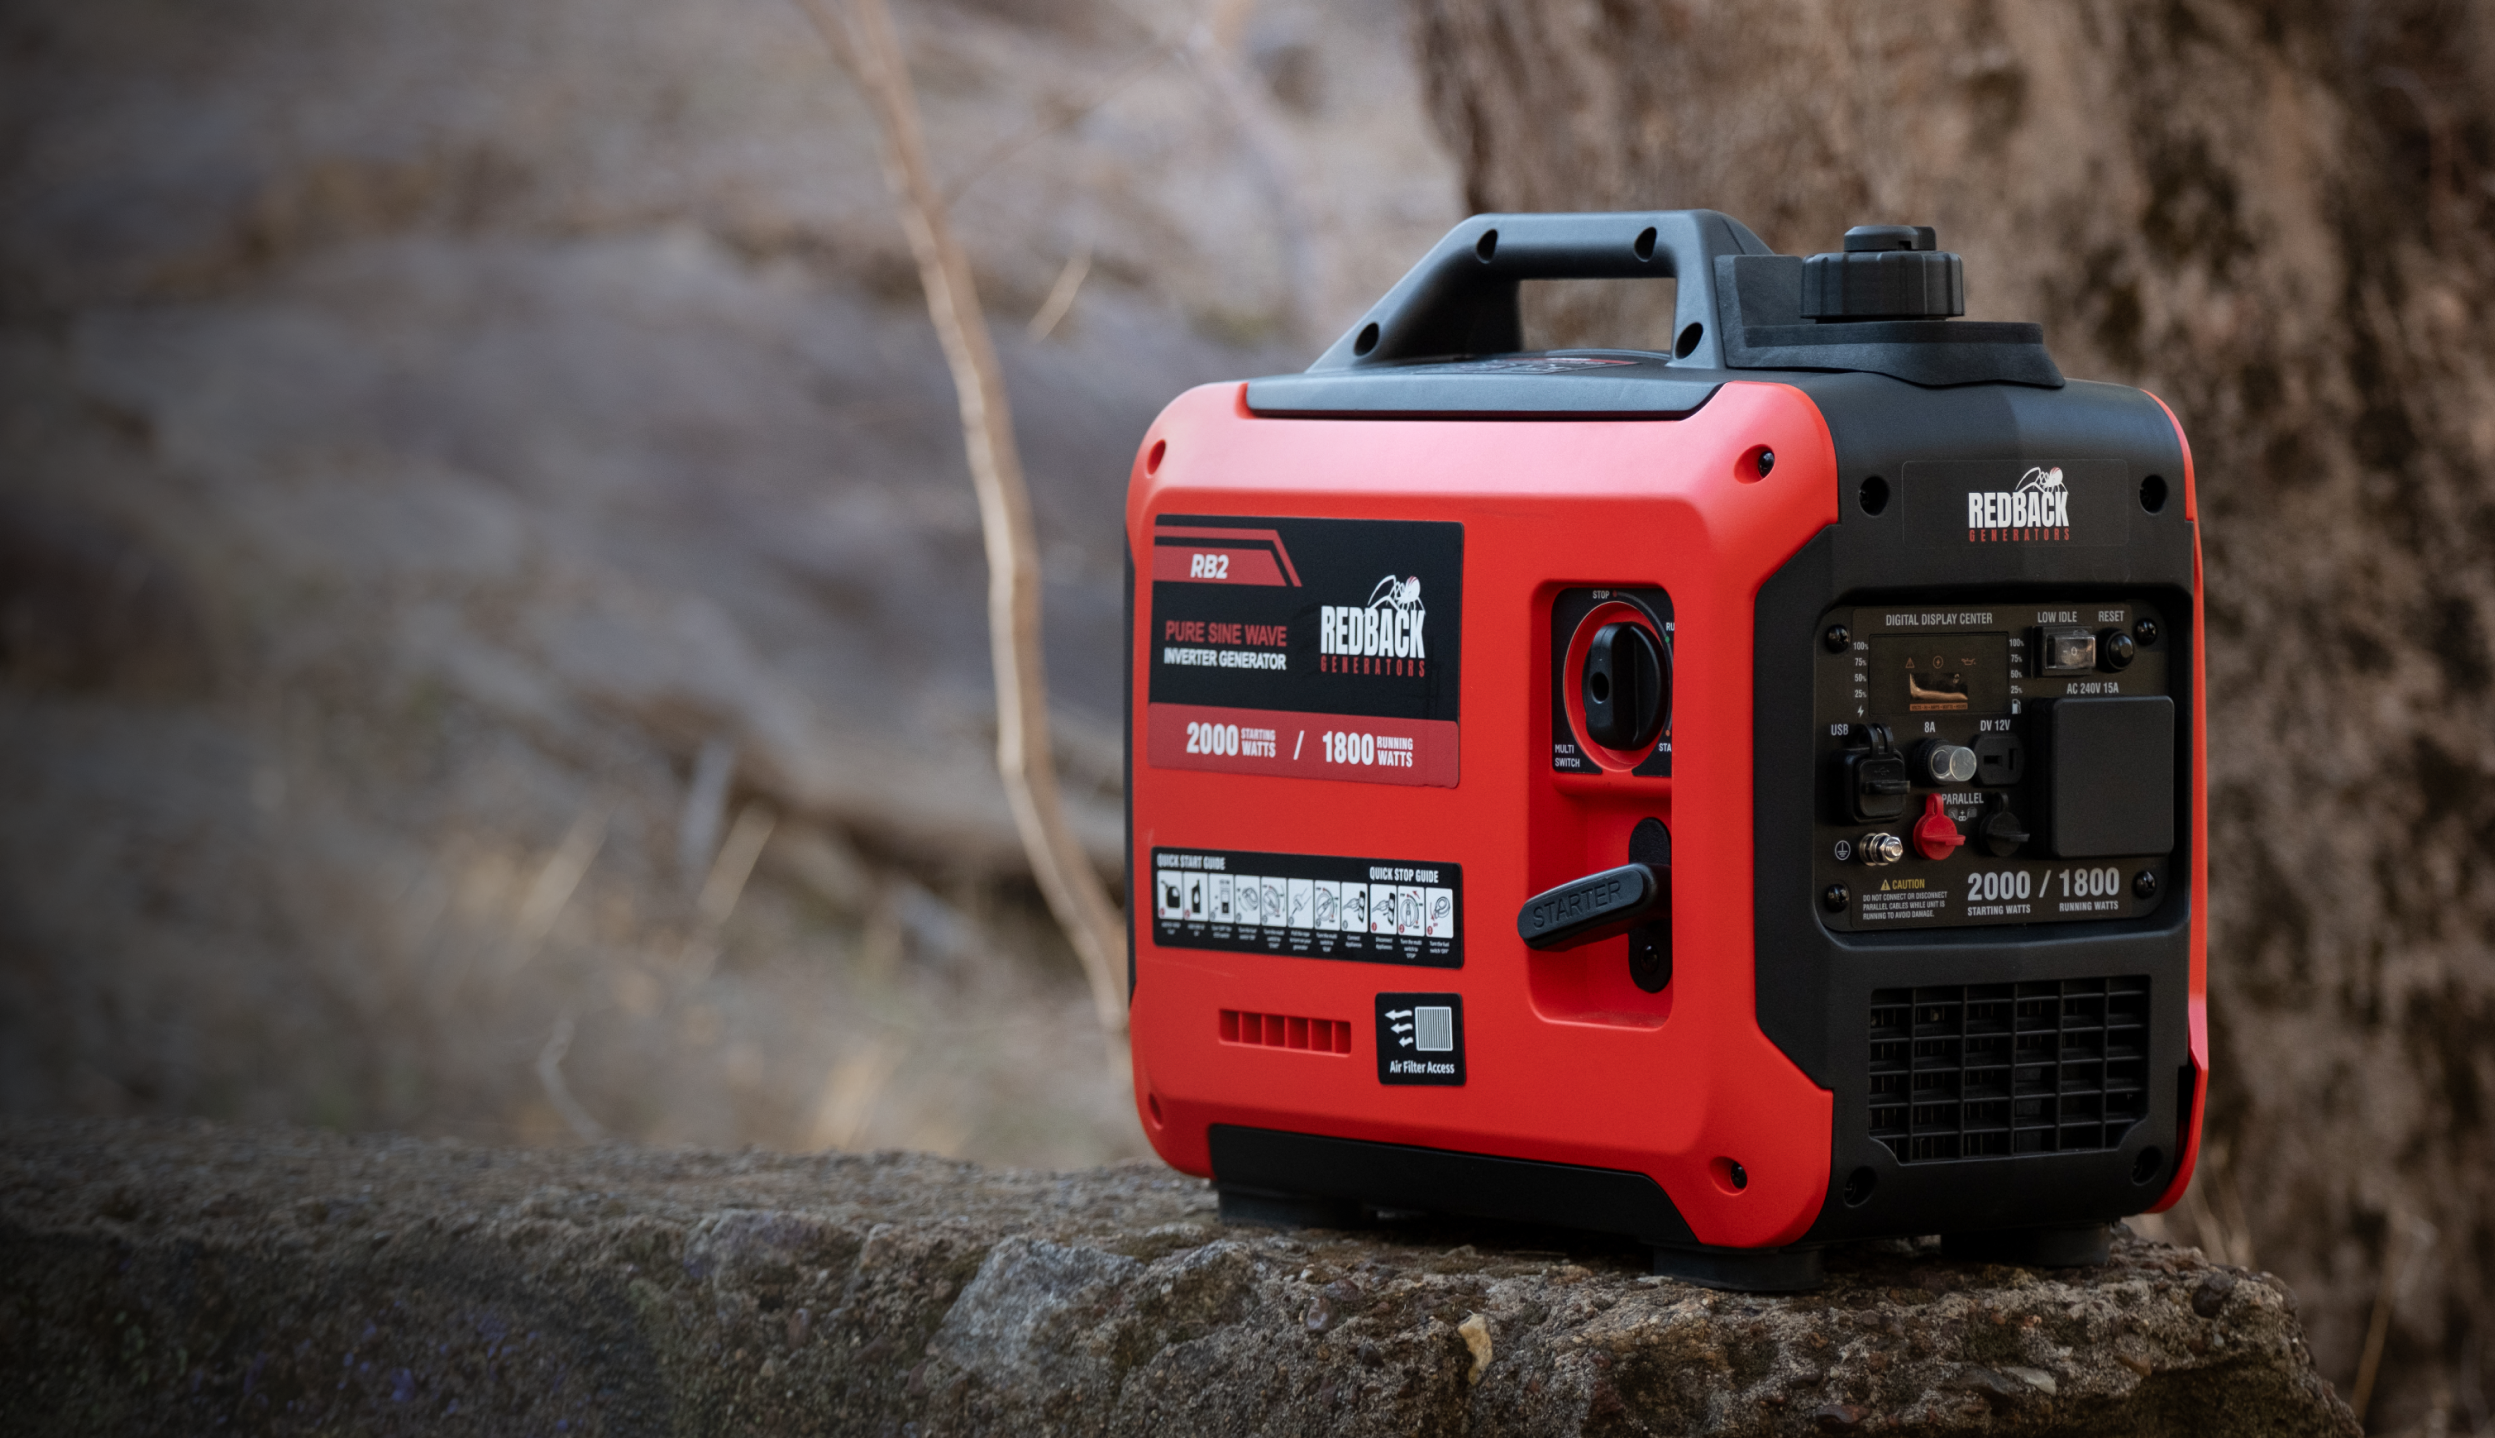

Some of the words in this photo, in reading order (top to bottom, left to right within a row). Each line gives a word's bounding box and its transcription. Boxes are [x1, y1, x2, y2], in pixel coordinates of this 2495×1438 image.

[1968, 491, 2069, 528] REDBACK
[1969, 528, 2069, 542] GENERATORS
[1190, 554, 1229, 579] RB2
[1592, 590, 1610, 599] STOP
[1886, 614, 1919, 626] DIGITAL
[1922, 614, 1957, 626] DISPLAY
[1959, 612, 1992, 625] CENTER
[2038, 612, 2056, 623] LOW
[2058, 611, 2078, 622] IDLE
[2098, 610, 2124, 622] RESET
[1166, 620, 1206, 643] PURE
[1208, 622, 1242, 645] SINE
[1245, 624, 1287, 647] WAVE
[1320, 606, 1426, 659] REDBACK
[1853, 642, 1868, 650] 100%
[1164, 647, 1218, 666] INVERTER
[1219, 650, 1287, 670] GENERATOR
[1854, 658, 1867, 666] 75%
[1320, 655, 1426, 678] GENERATORS
[1854, 674, 1867, 682] 50%
[1854, 690, 1867, 698] 25%
[2066, 683, 2078, 694] AC
[2080, 682, 2101, 694] 240V
[2103, 682, 2119, 694] 15A
[1830, 724, 1848, 736] USB
[1924, 722, 1936, 732] 8A
[1980, 720, 1992, 732] DV
[1994, 719, 2011, 731] 12V
[1241, 728, 1276, 742] STARTING
[1186, 722, 1238, 756] 2000
[1322, 730, 1374, 766] 1800
[1242, 740, 1276, 758] WATTS
[1377, 736, 1413, 750] RUNNING
[1554, 744, 1574, 754] MULTI
[1378, 750, 1413, 768] WATTS
[1554, 758, 1580, 768] SWITCH
[1942, 792, 1984, 804] PARALLEL
[1157, 853, 1180, 868] QUICK
[1180, 854, 1202, 868] START
[1203, 856, 1226, 870] GUIDE
[1370, 866, 1394, 880] QUICK
[1394, 868, 1414, 882] STOP
[1416, 870, 1439, 884] GUIDE
[1892, 878, 1925, 890] CAUTION
[1968, 870, 2030, 901] 2000
[2059, 867, 2120, 896] 1800
[1916, 891, 1948, 899] DISCONNECT
[1533, 880, 1622, 929] STARTER
[1889, 902, 1908, 910] CABLES
[1968, 905, 2003, 916] STARTING
[2006, 904, 2030, 914] WATTS
[2059, 902, 2092, 912] RUNNING
[2094, 900, 2118, 910] WATTS
[1390, 1060, 1402, 1074] Air
[1403, 1060, 1426, 1074] Filter
[1426, 1061, 1454, 1074] Access
